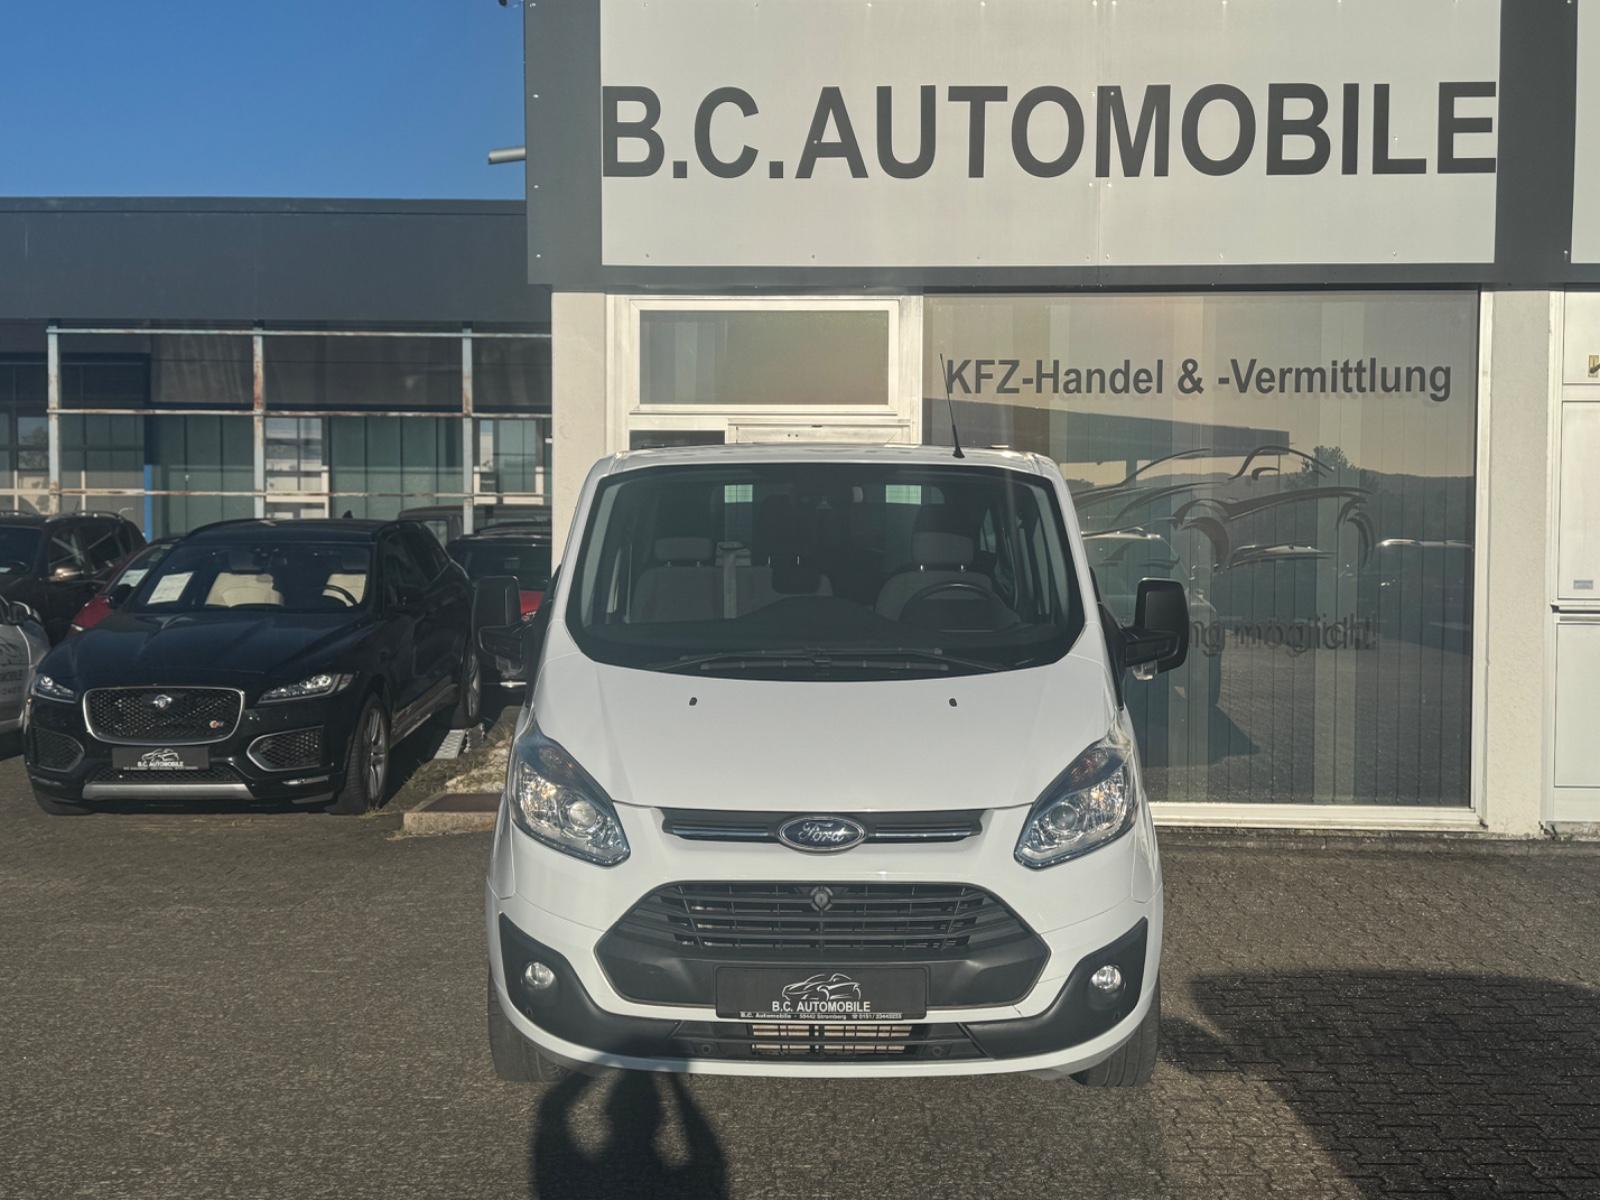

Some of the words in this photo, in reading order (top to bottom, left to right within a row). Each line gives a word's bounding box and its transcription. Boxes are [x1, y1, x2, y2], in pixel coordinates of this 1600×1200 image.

[945, 358, 1164, 395] KFZ-Handel
[1177, 358, 1204, 394] &
[1217, 357, 1452, 402] -Vermittlung
[798, 822, 848, 842] Ford
[772, 1001, 793, 1013] B.C.
[796, 1001, 871, 1012] AUTOMOBILE
